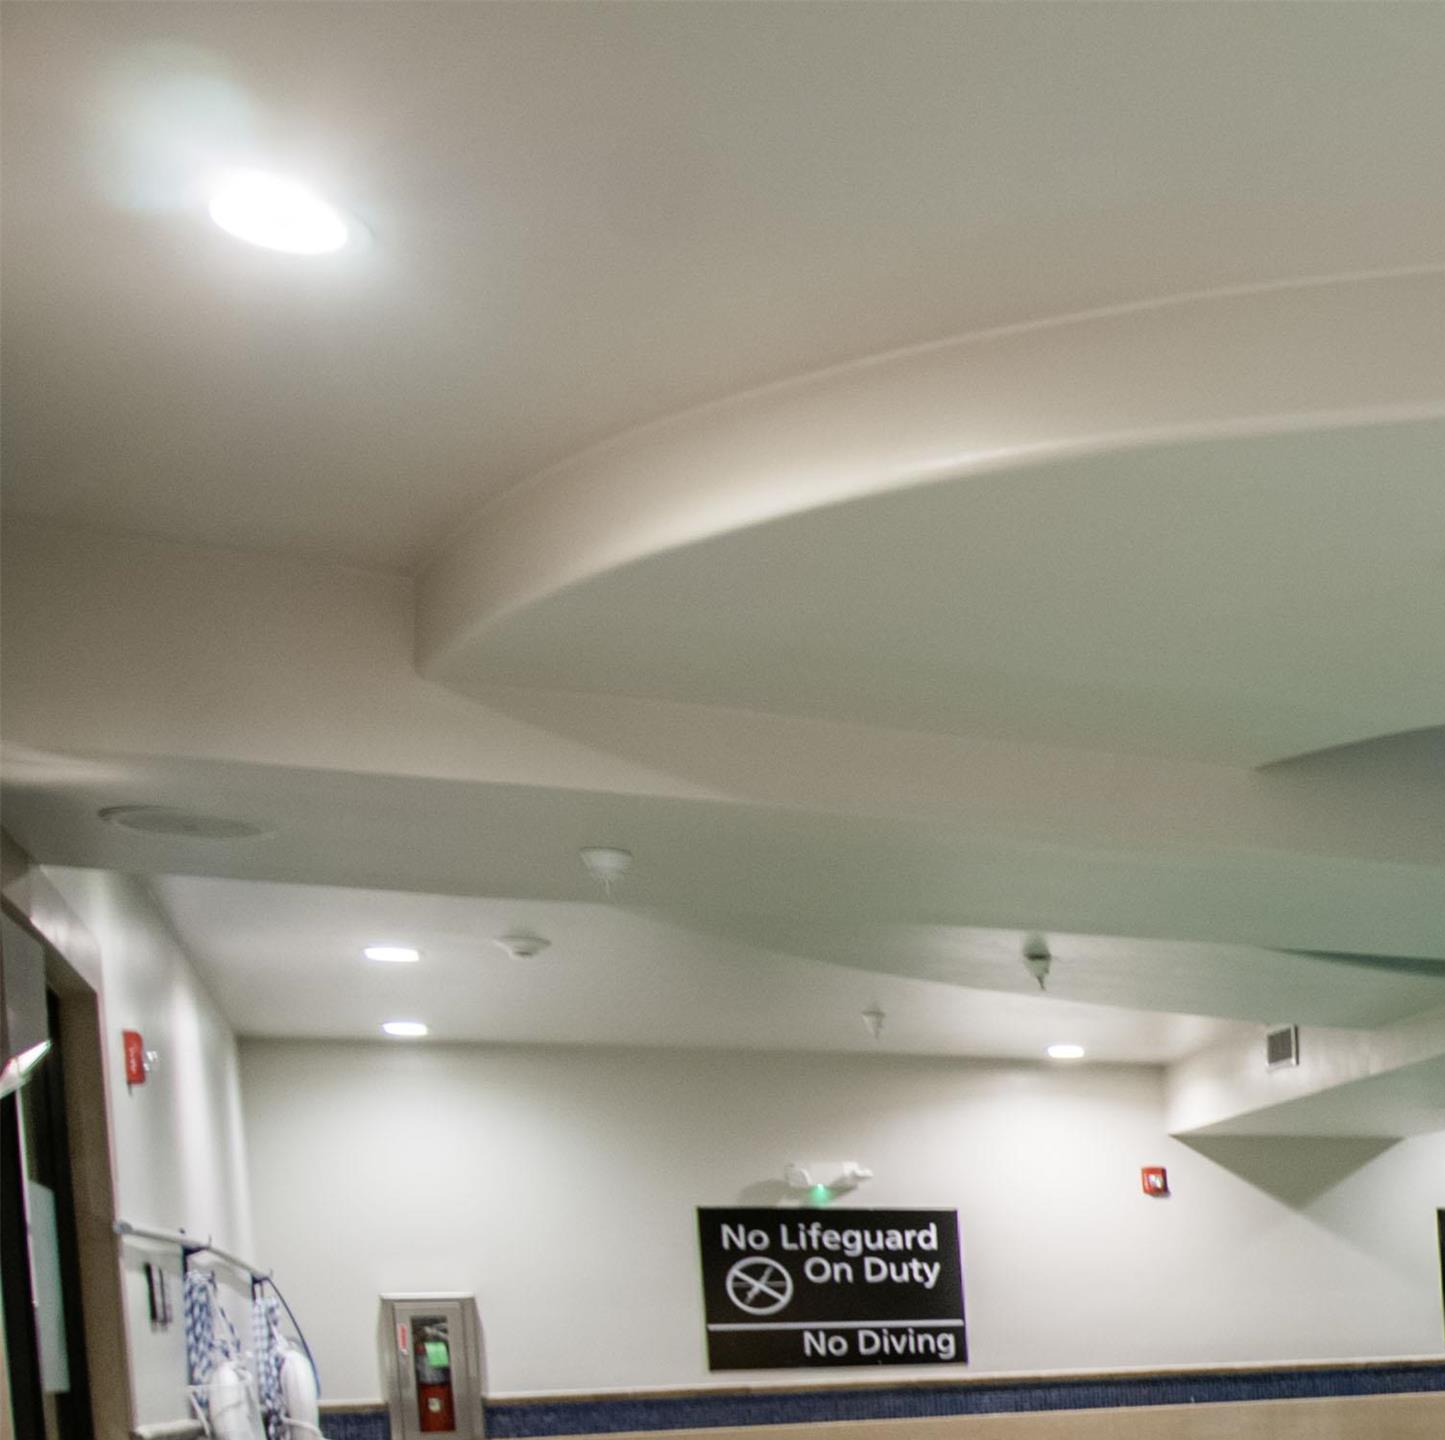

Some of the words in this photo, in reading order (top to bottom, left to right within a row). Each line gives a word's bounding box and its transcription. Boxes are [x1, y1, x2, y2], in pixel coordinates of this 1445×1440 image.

[721, 1223, 770, 1251] No
[780, 1222, 938, 1257] Lifeguard
[804, 1256, 853, 1283] On
[864, 1256, 940, 1289] Duty
[803, 1330, 848, 1357] No
[858, 1328, 955, 1360] Diving
